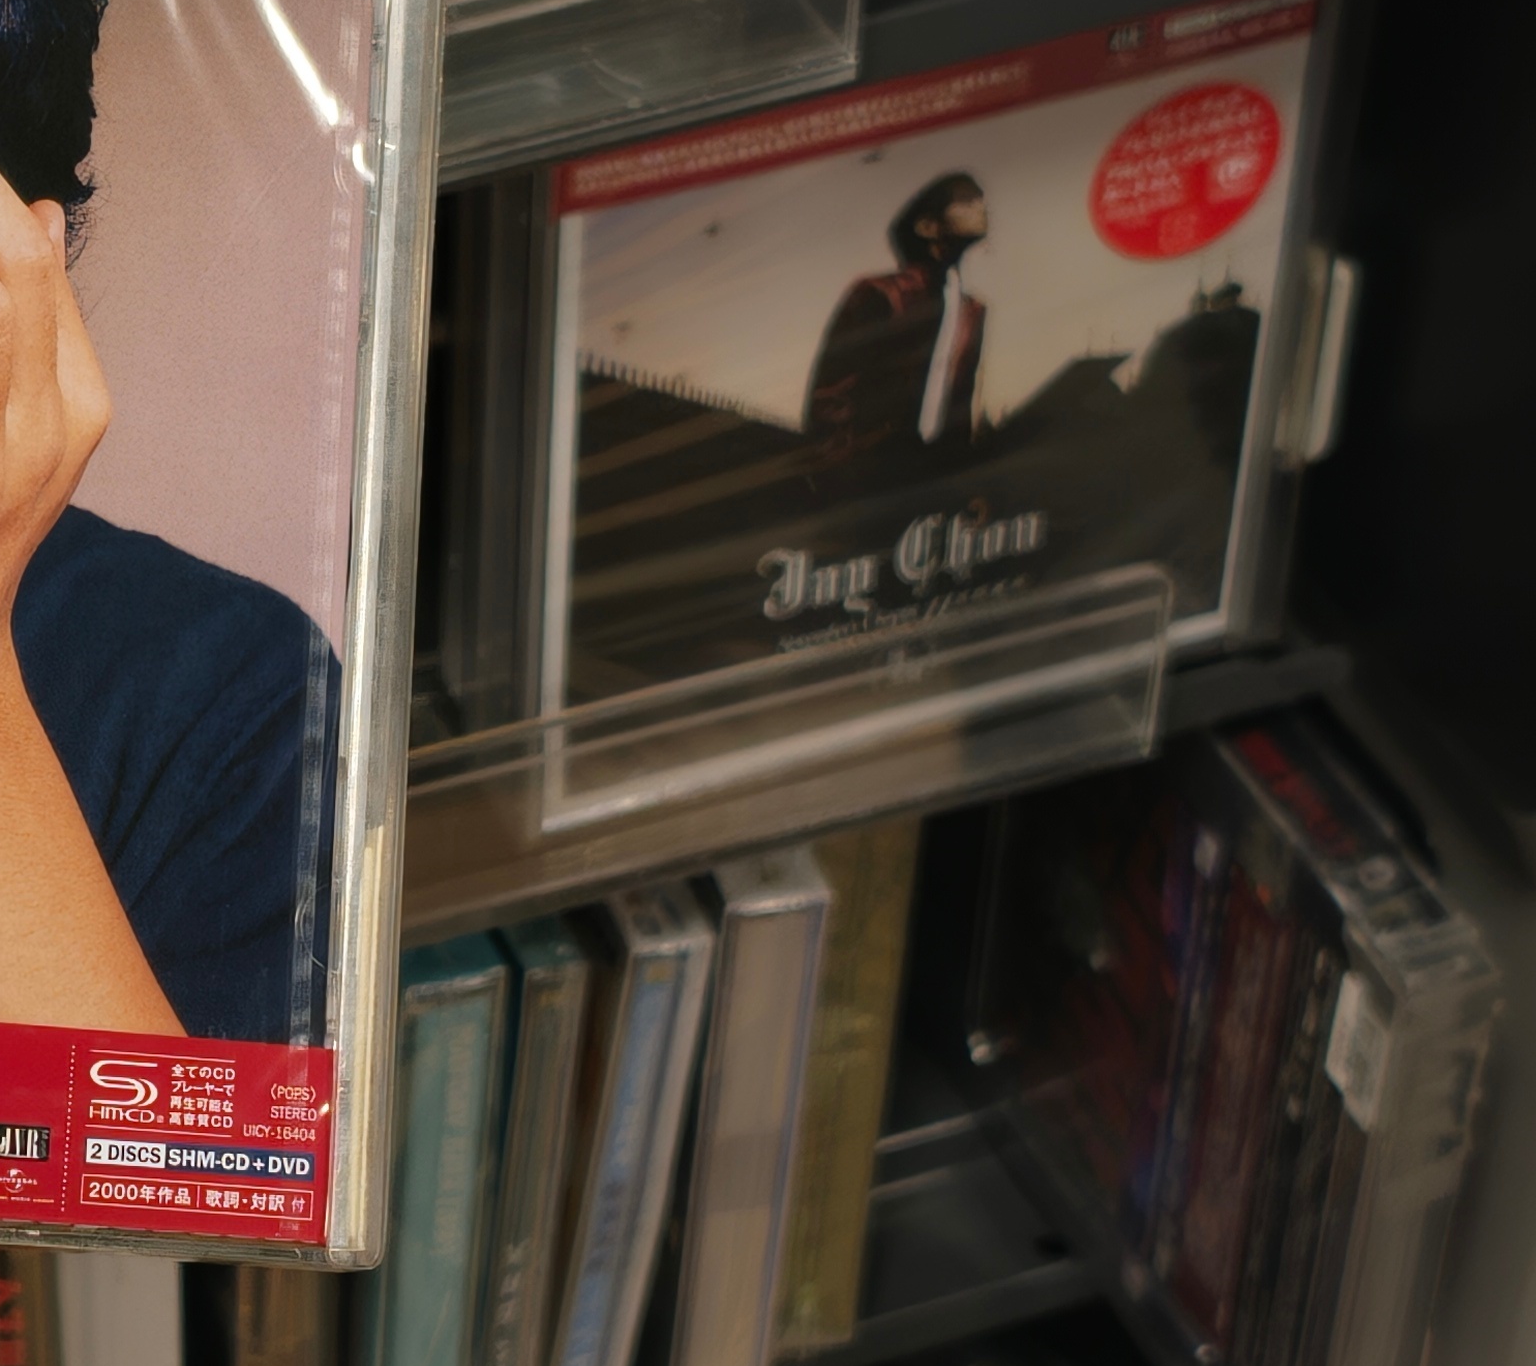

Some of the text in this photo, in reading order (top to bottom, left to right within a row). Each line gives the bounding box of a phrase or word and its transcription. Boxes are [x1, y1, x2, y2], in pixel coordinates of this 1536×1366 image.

[171, 1063, 236, 1081] 全てのCD
[171, 1080, 235, 1095] プレーヤーで
[170, 1096, 234, 1113] 再生可能な
[168, 1112, 234, 1129] 高音質CD
[270, 1105, 317, 1122] STEREO
[91, 1142, 162, 1165] 2 DISCS
[88, 1181, 191, 1206] 2000年作品
